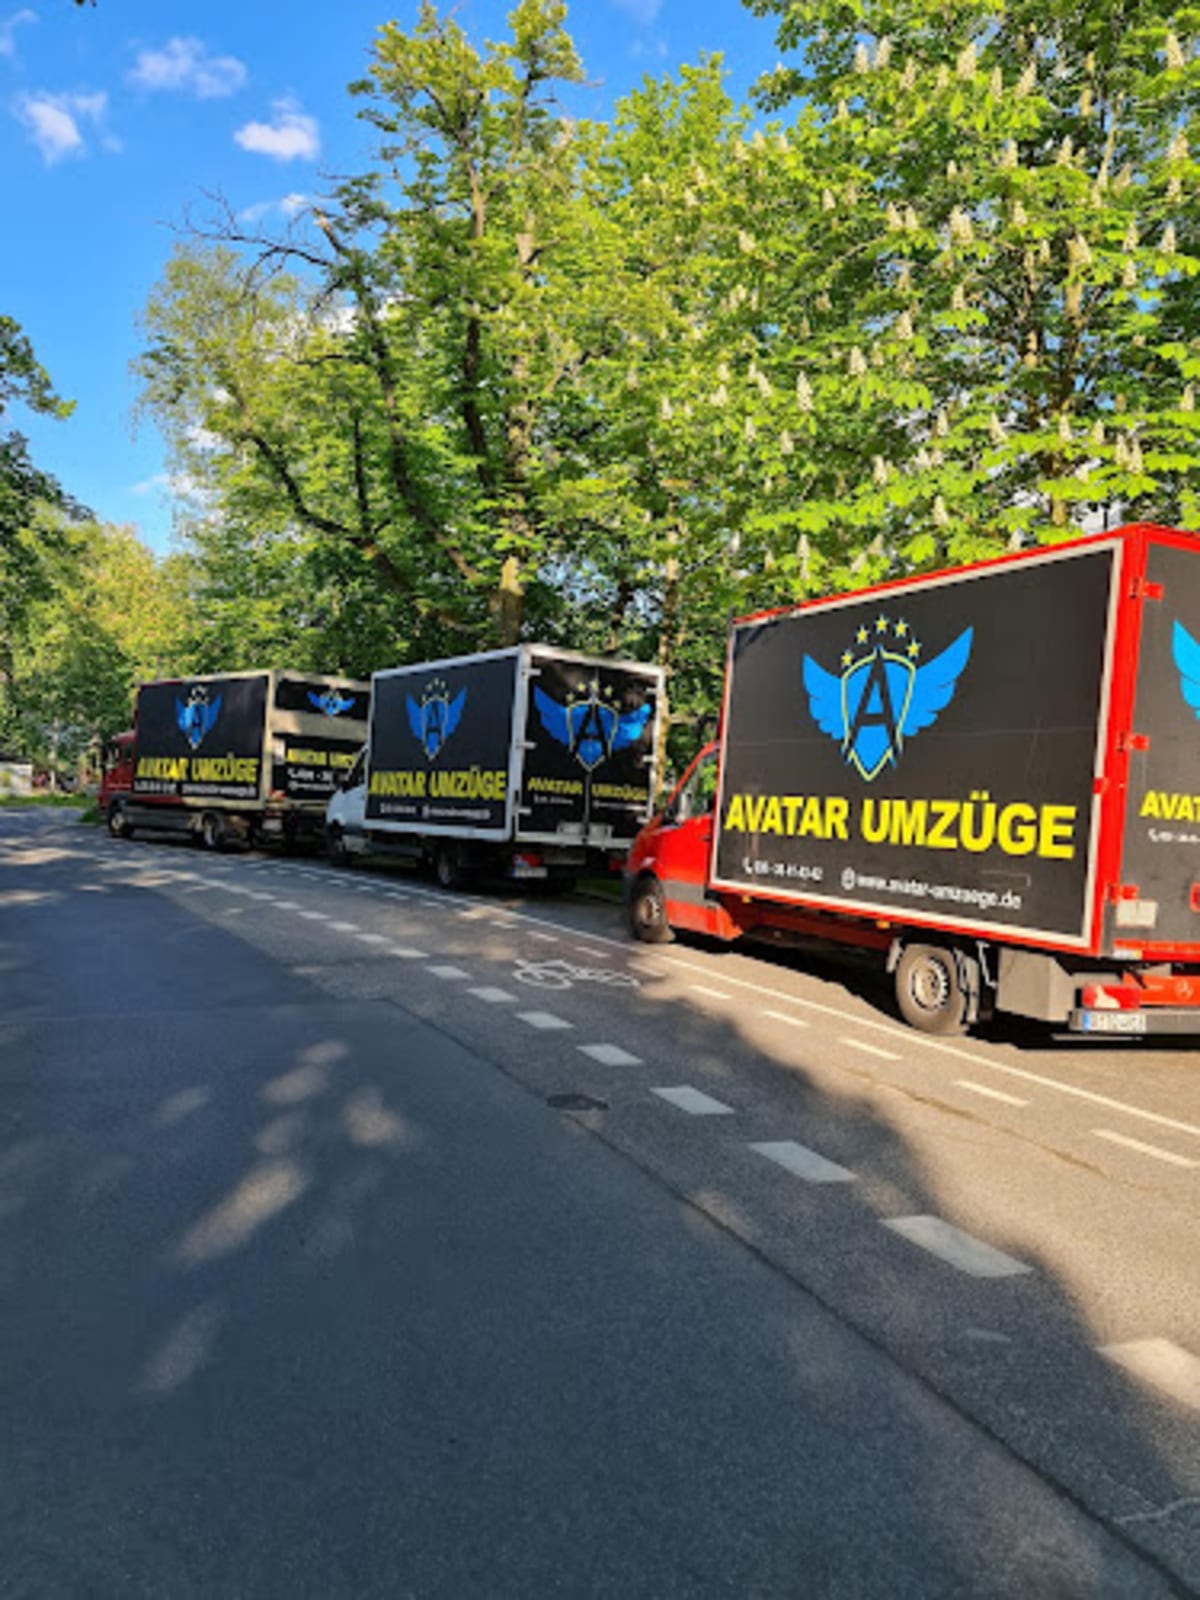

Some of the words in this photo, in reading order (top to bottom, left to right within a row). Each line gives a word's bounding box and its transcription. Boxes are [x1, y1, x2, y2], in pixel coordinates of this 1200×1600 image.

[848, 648, 899, 757] A
[368, 771, 426, 797] AVATAR
[429, 765, 506, 800] UMZÜGE
[724, 795, 849, 840] AVATAR
[861, 789, 1077, 859] UMZÜGE
